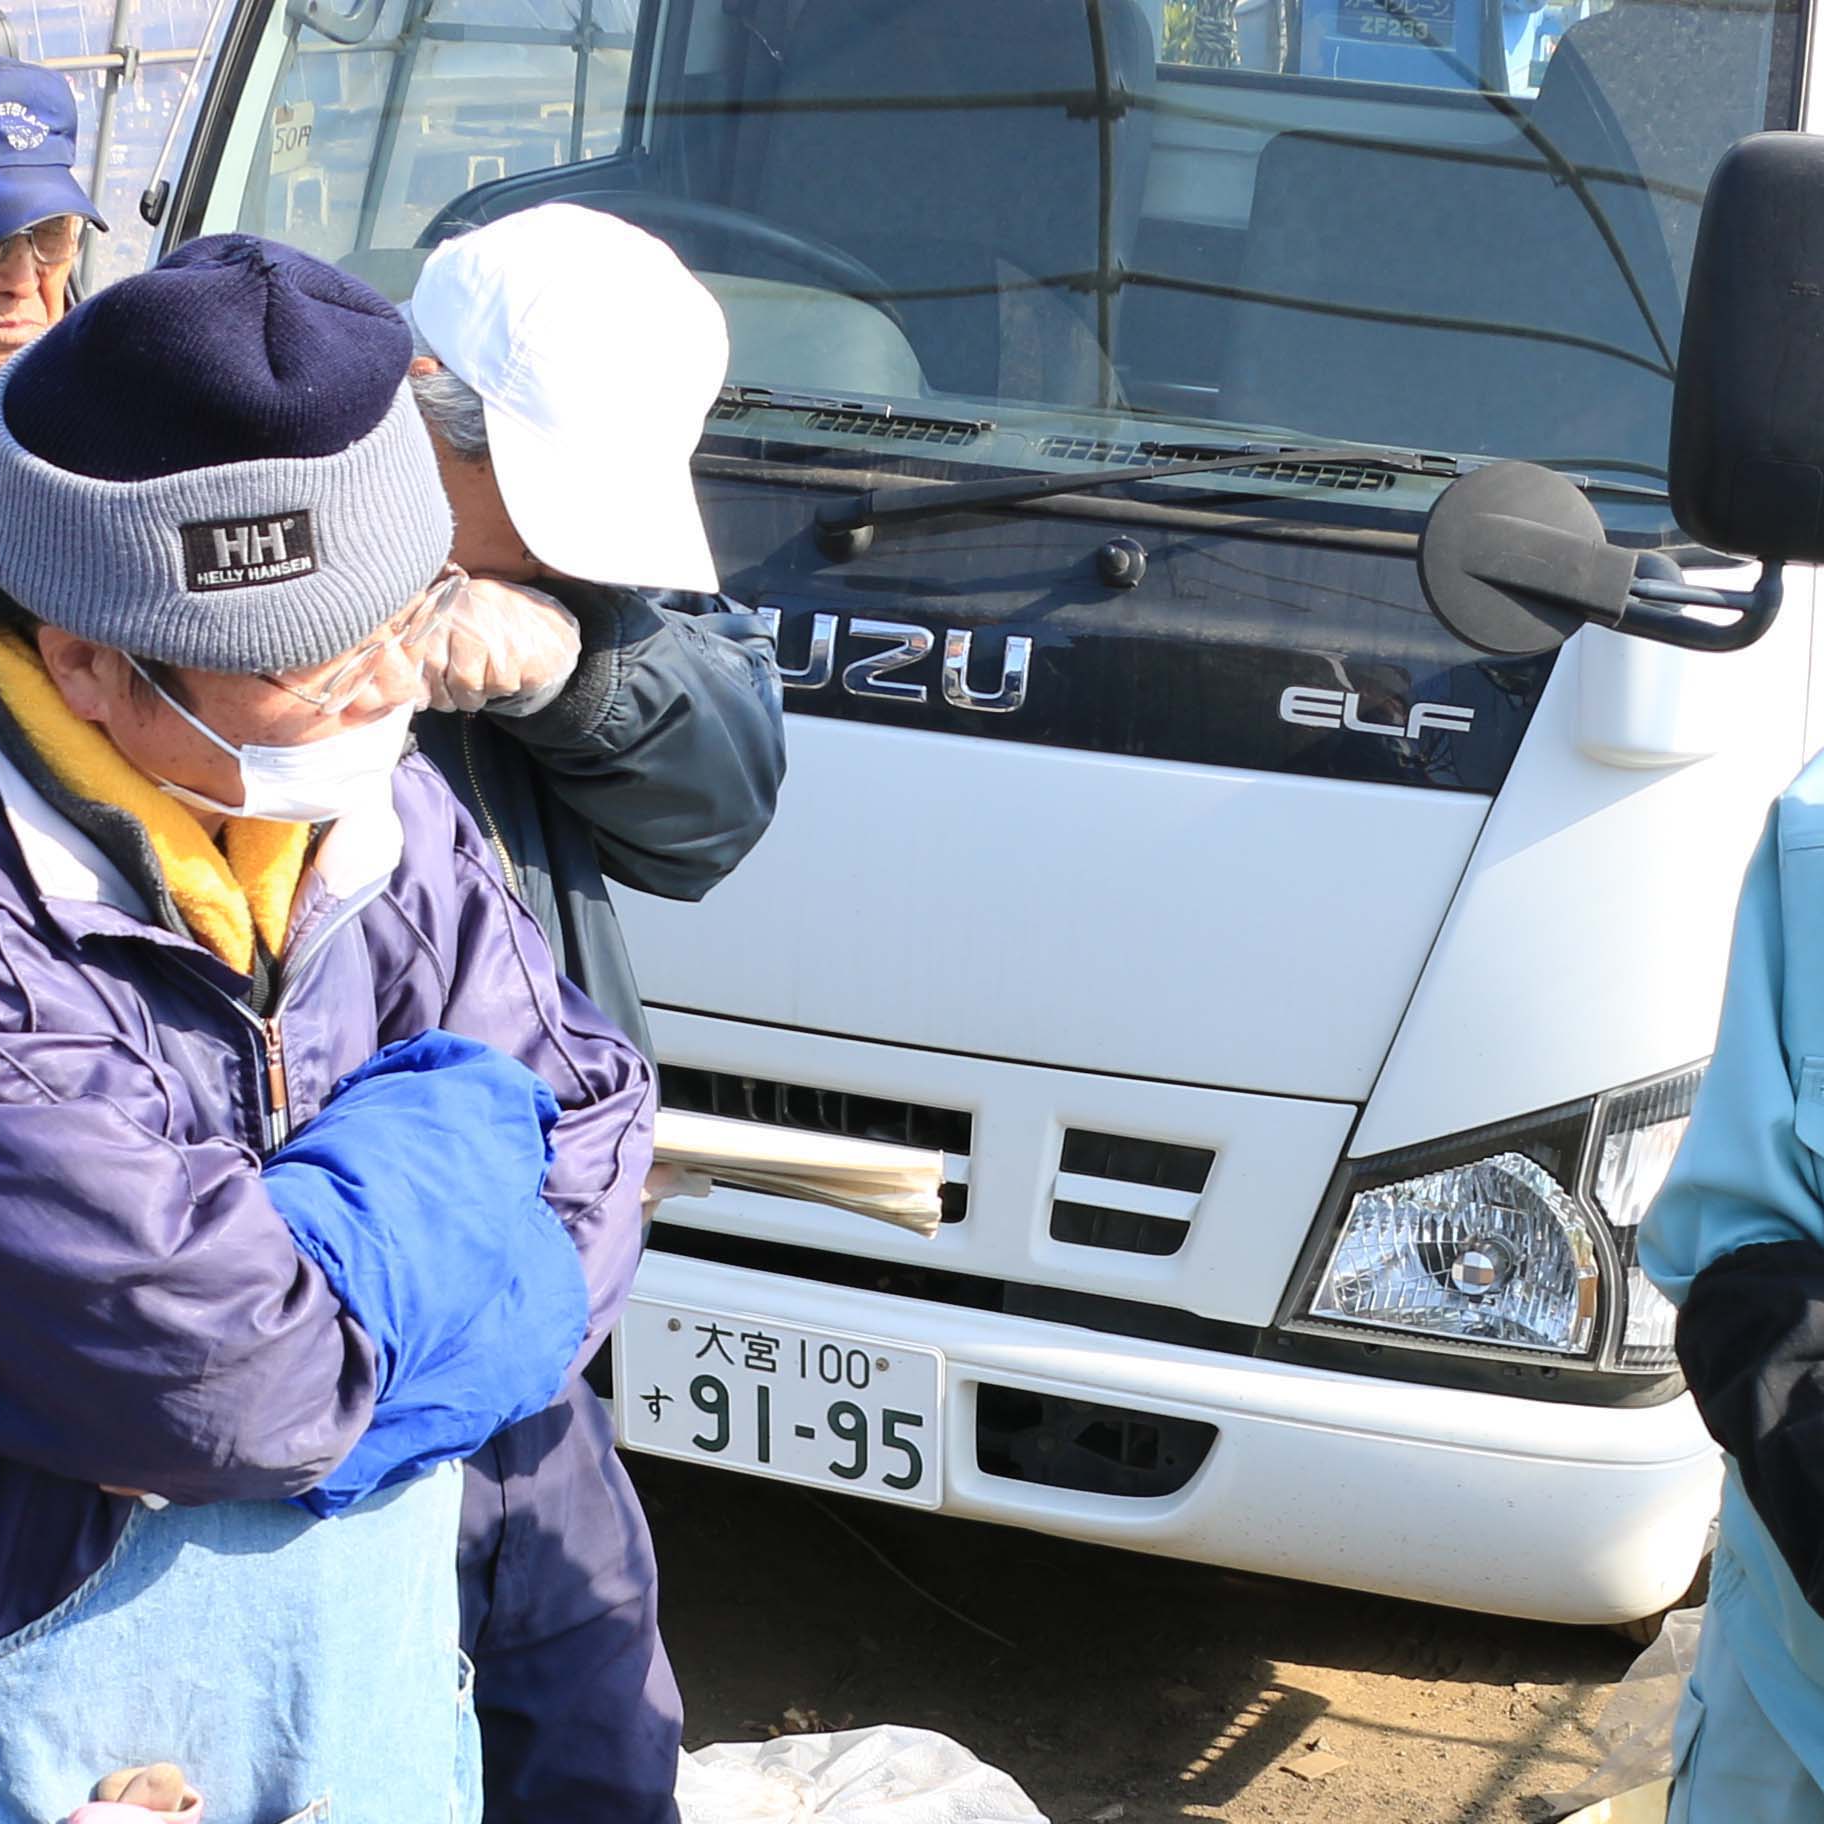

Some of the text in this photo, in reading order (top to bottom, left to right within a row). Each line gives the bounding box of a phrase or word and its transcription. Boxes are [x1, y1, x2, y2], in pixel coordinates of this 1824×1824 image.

[1360, 16, 1429, 39] ZF233
[197, 556, 312, 586] HELLY HANSEN
[213, 522, 287, 568] HH
[759, 605, 1033, 713] UZU
[1280, 685, 1475, 738] ELF
[695, 1322, 870, 1389] 大宮 100
[639, 1374, 924, 1490] す 91-95
